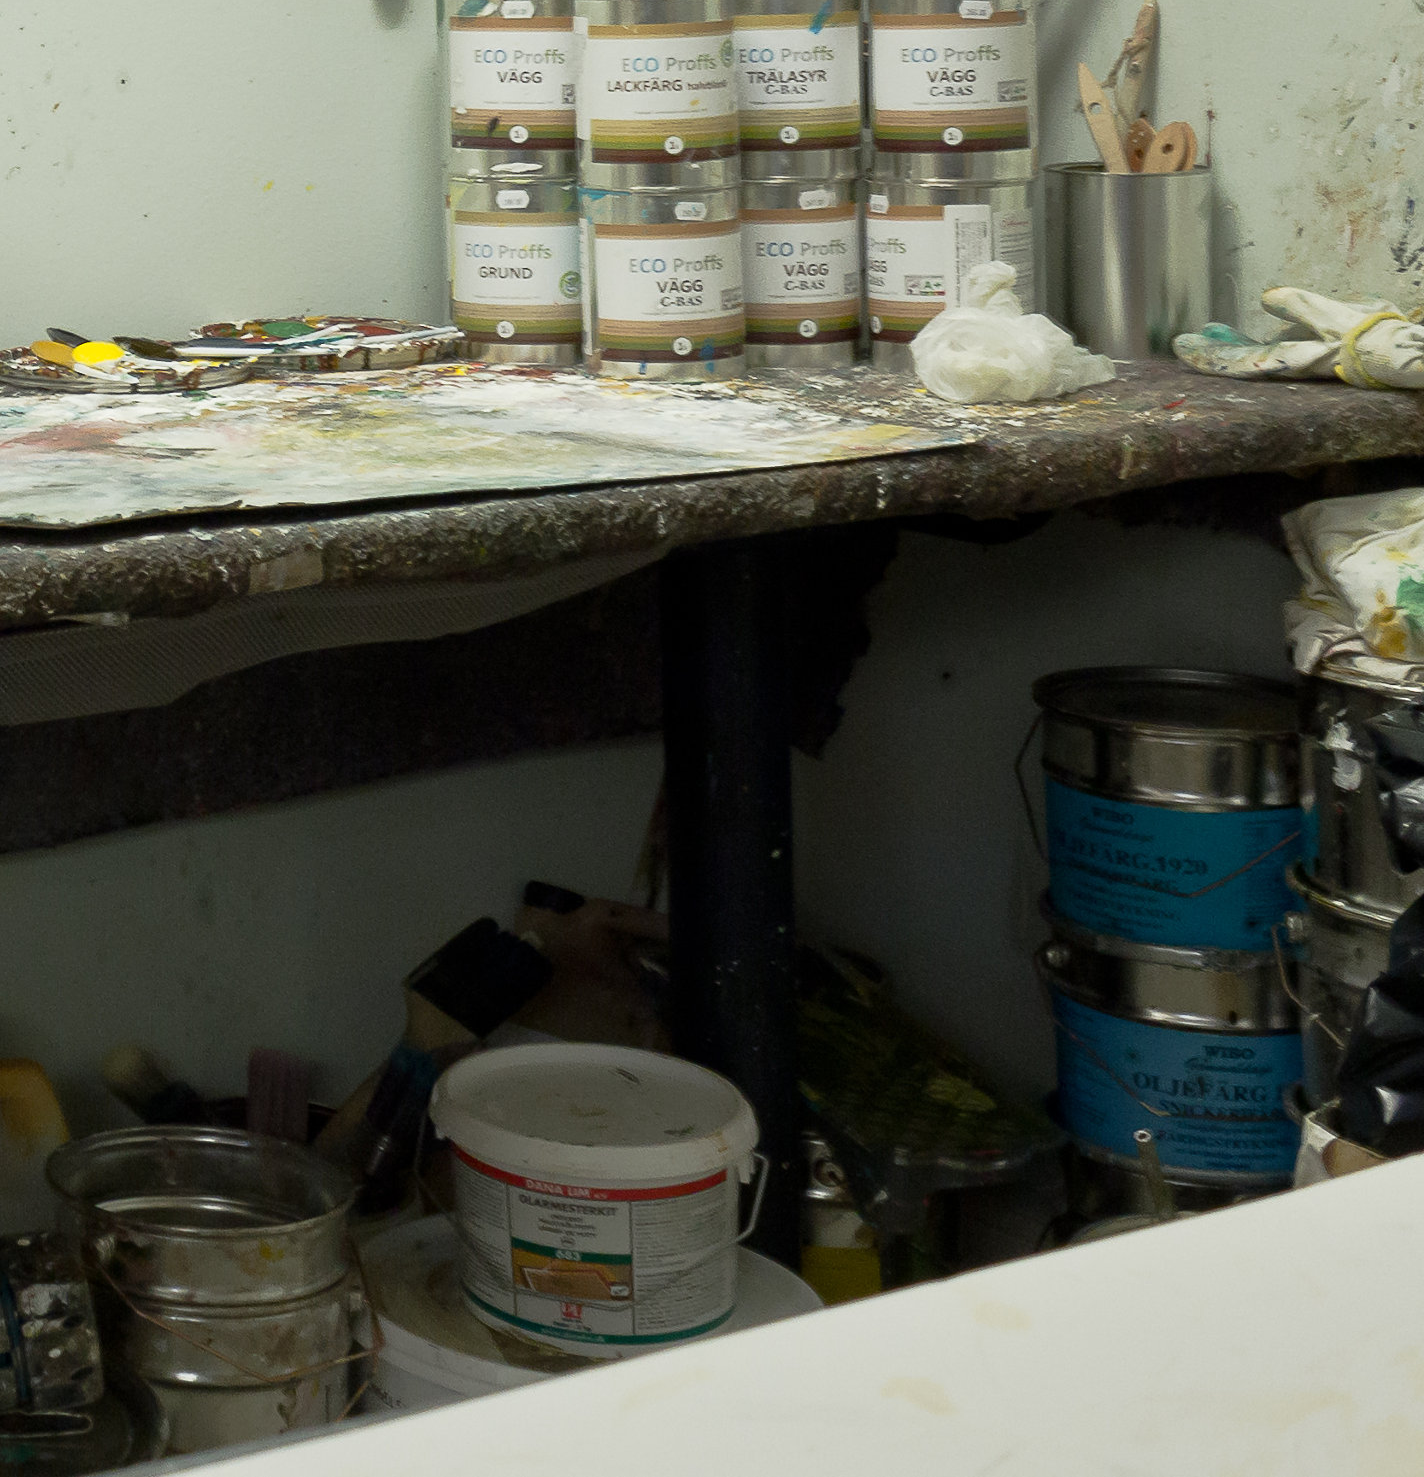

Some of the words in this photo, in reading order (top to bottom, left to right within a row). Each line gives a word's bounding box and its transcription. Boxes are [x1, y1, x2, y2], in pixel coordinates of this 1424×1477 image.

[474, 49, 507, 64] ECO
[513, 49, 565, 65] Proffs
[738, 48, 775, 63] ECO
[781, 45, 834, 62] Proffs
[901, 47, 937, 63] ECO
[944, 44, 1001, 62] Proffs
[622, 57, 660, 73] ECO
[666, 53, 718, 72] Proffs
[496, 68, 543, 84] VÄGG
[745, 68, 828, 84] TRÄLASYR
[926, 67, 977, 83] VÄGG
[607, 77, 683, 93] LACKFÄRG
[764, 84, 809, 95] C-BAS
[929, 85, 975, 97] C-BAS
[465, 243, 494, 258] ECO
[499, 244, 553, 259] Proffs
[756, 242, 794, 257] ECO
[801, 239, 847, 257] Proffs
[629, 258, 666, 273] ECO
[673, 254, 724, 273] Proffs
[783, 262, 829, 277] VÄGG
[479, 266, 533, 280] GRUND
[656, 278, 704, 293] VÄGG
[660, 296, 703, 307] C-BAS
[1204, 1045, 1256, 1060] WIBO
[525, 1180, 564, 1195] DANA
[566, 1187, 591, 1199] LIM
